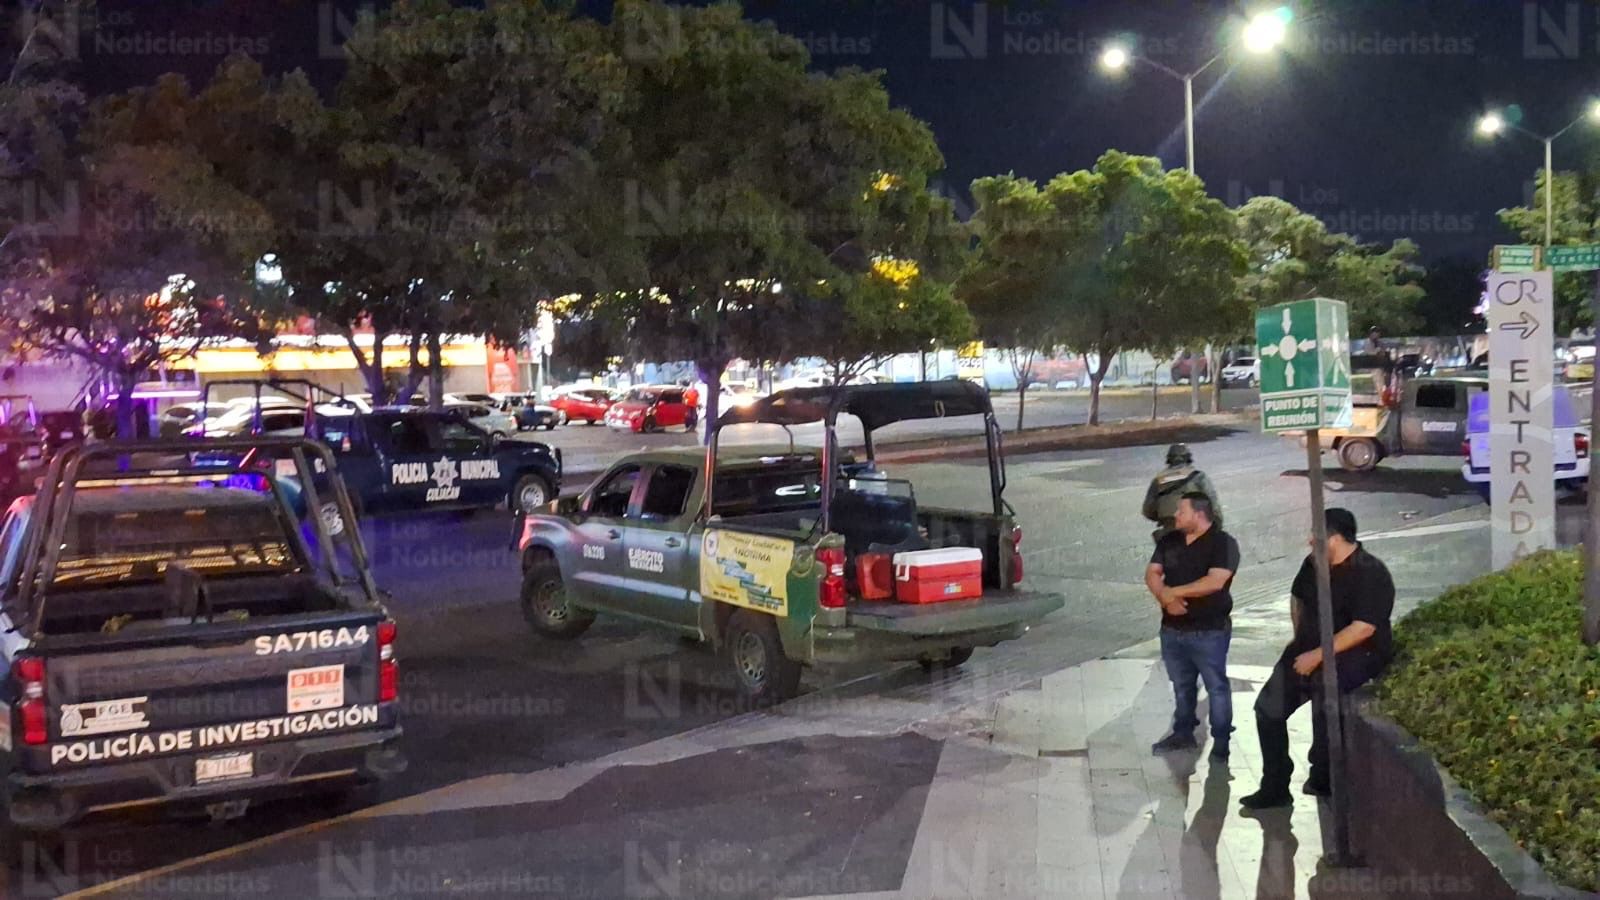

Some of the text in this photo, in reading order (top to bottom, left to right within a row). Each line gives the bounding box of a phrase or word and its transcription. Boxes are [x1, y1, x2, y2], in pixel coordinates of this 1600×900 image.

[1265, 396, 1317, 411] PUNTO DE
[1268, 411, 1317, 427] REUNIÓN
[460, 459, 501, 480] MUNICIPAL
[254, 625, 370, 656] SA716A4
[51, 704, 378, 765] POLICÍA DE INVESTIGACIÓN
